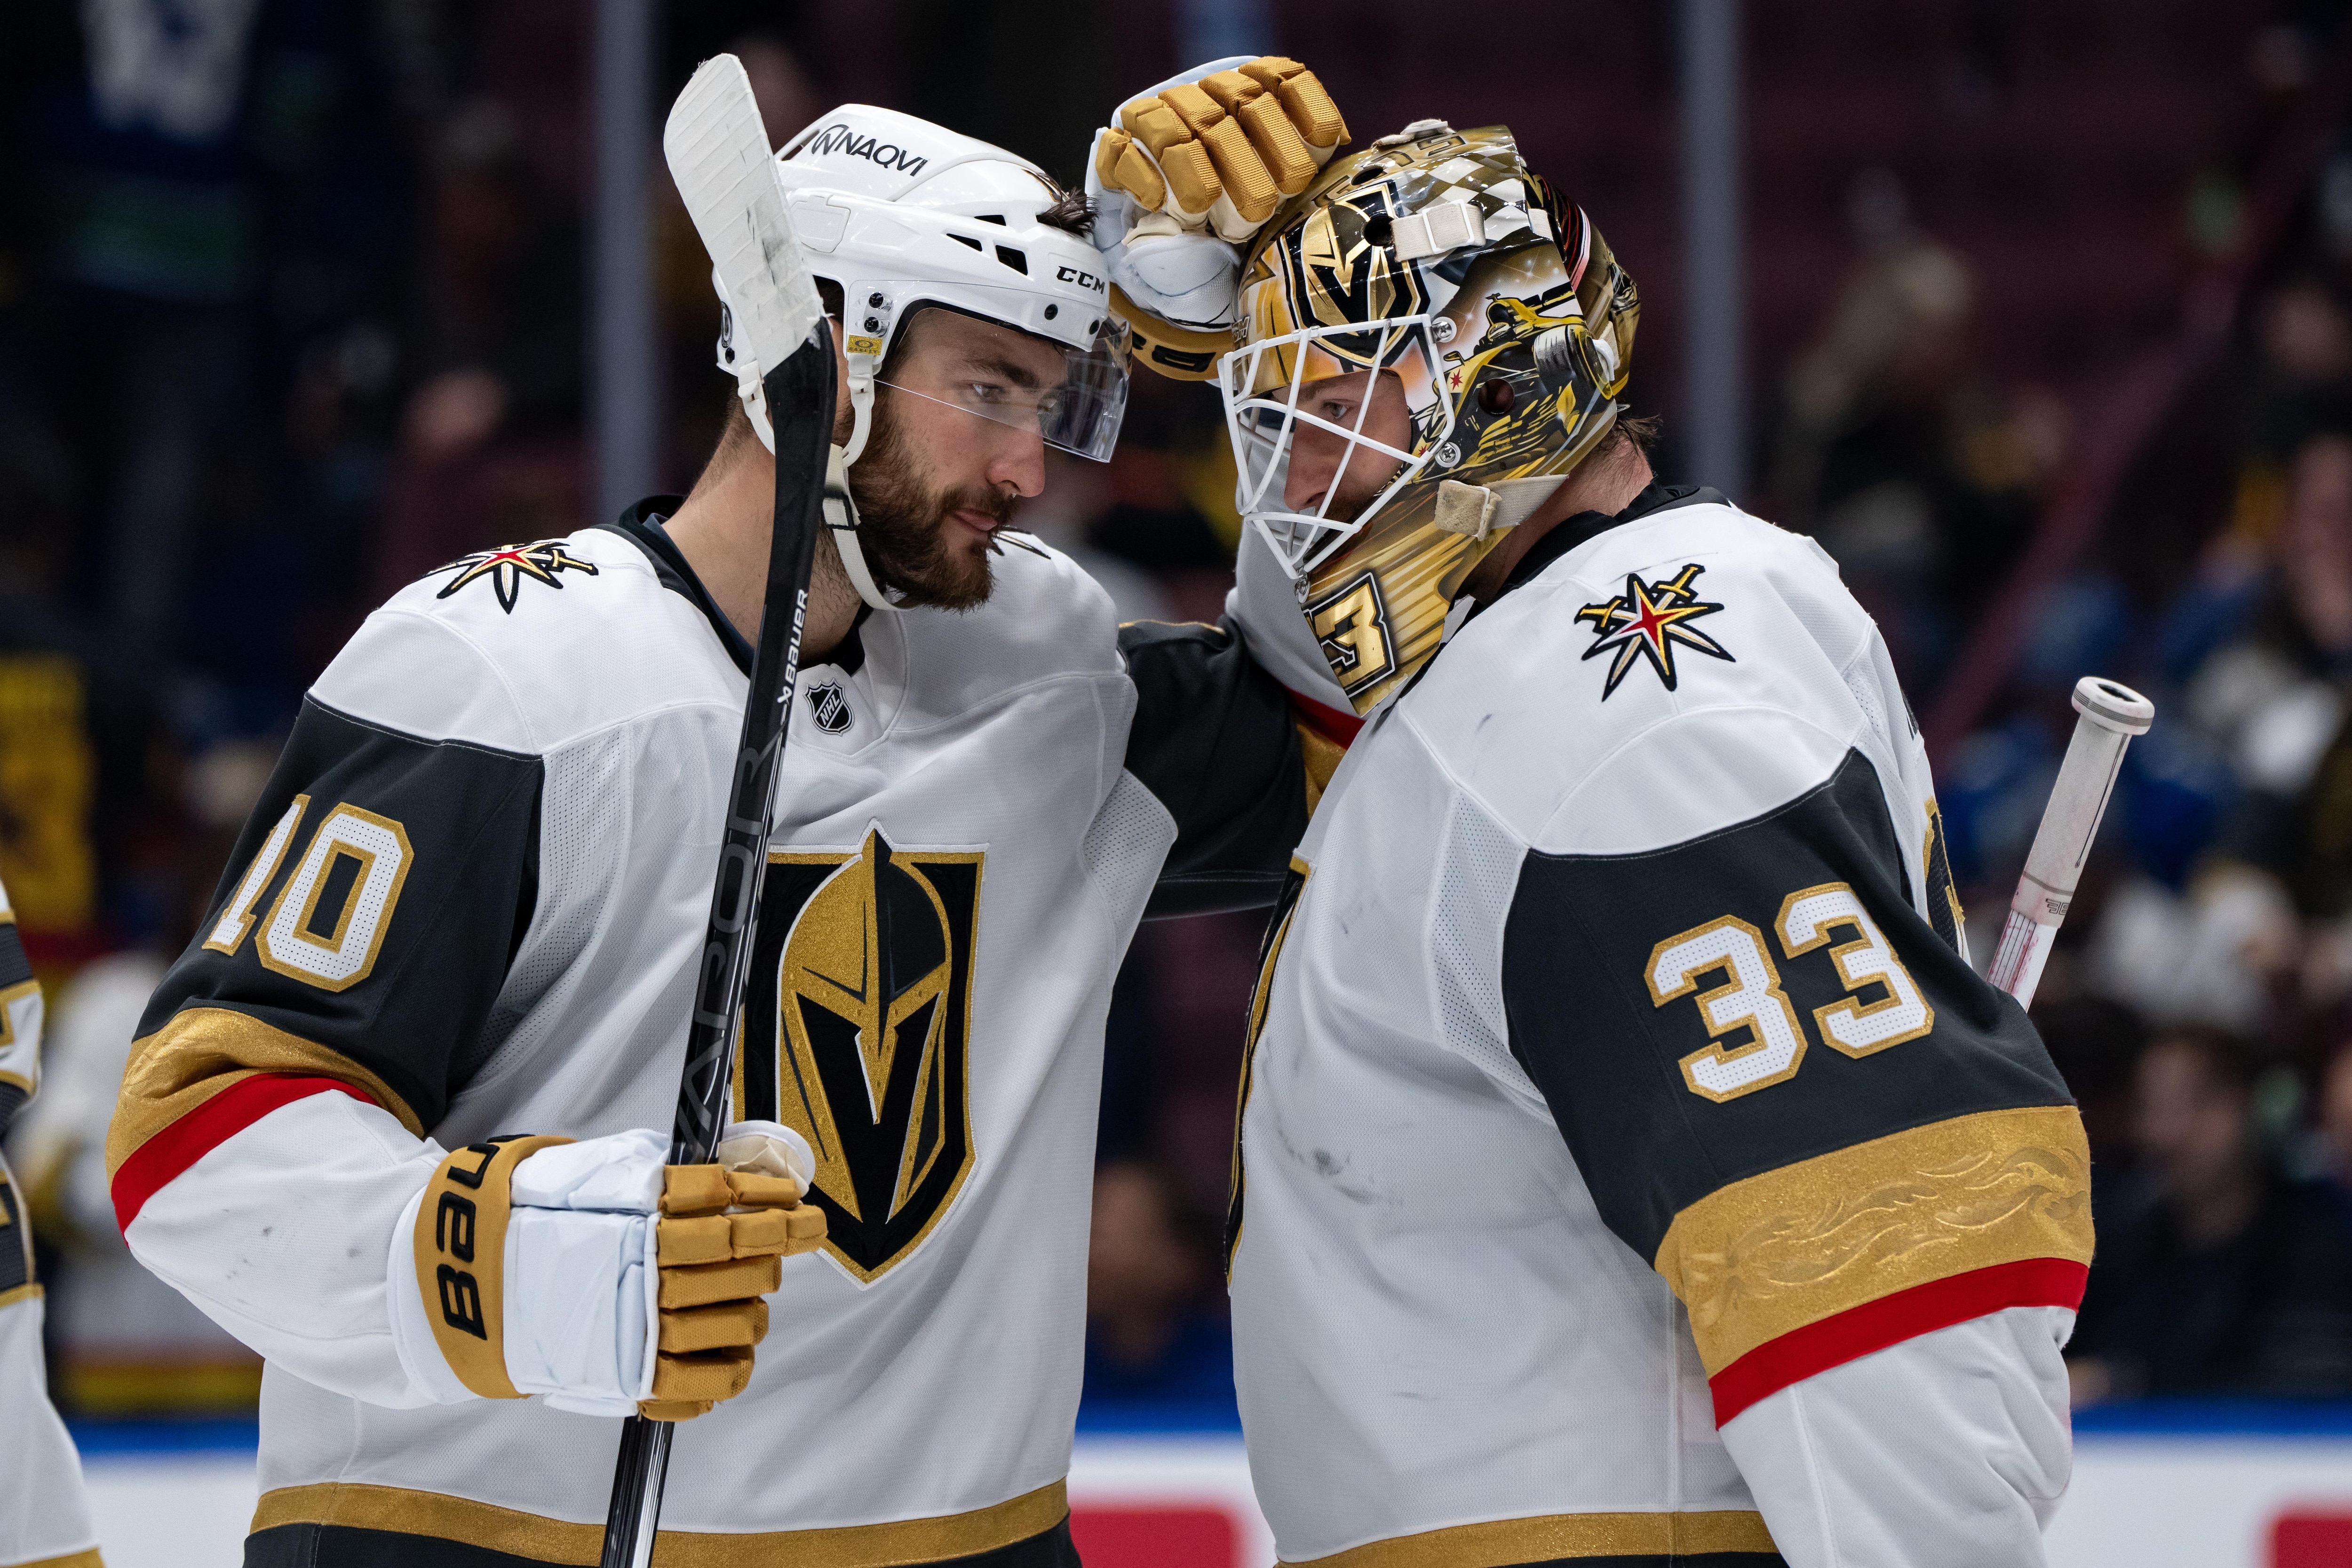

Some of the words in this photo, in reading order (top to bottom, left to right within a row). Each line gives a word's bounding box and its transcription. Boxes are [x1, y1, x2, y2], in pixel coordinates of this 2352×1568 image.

[834, 132, 928, 177] NAQVI
[1057, 266, 1105, 294] CCM
[785, 589, 808, 685] BAUER
[820, 694, 840, 725] NHL
[202, 794, 414, 993] 10
[1643, 882, 1935, 1104] 33
